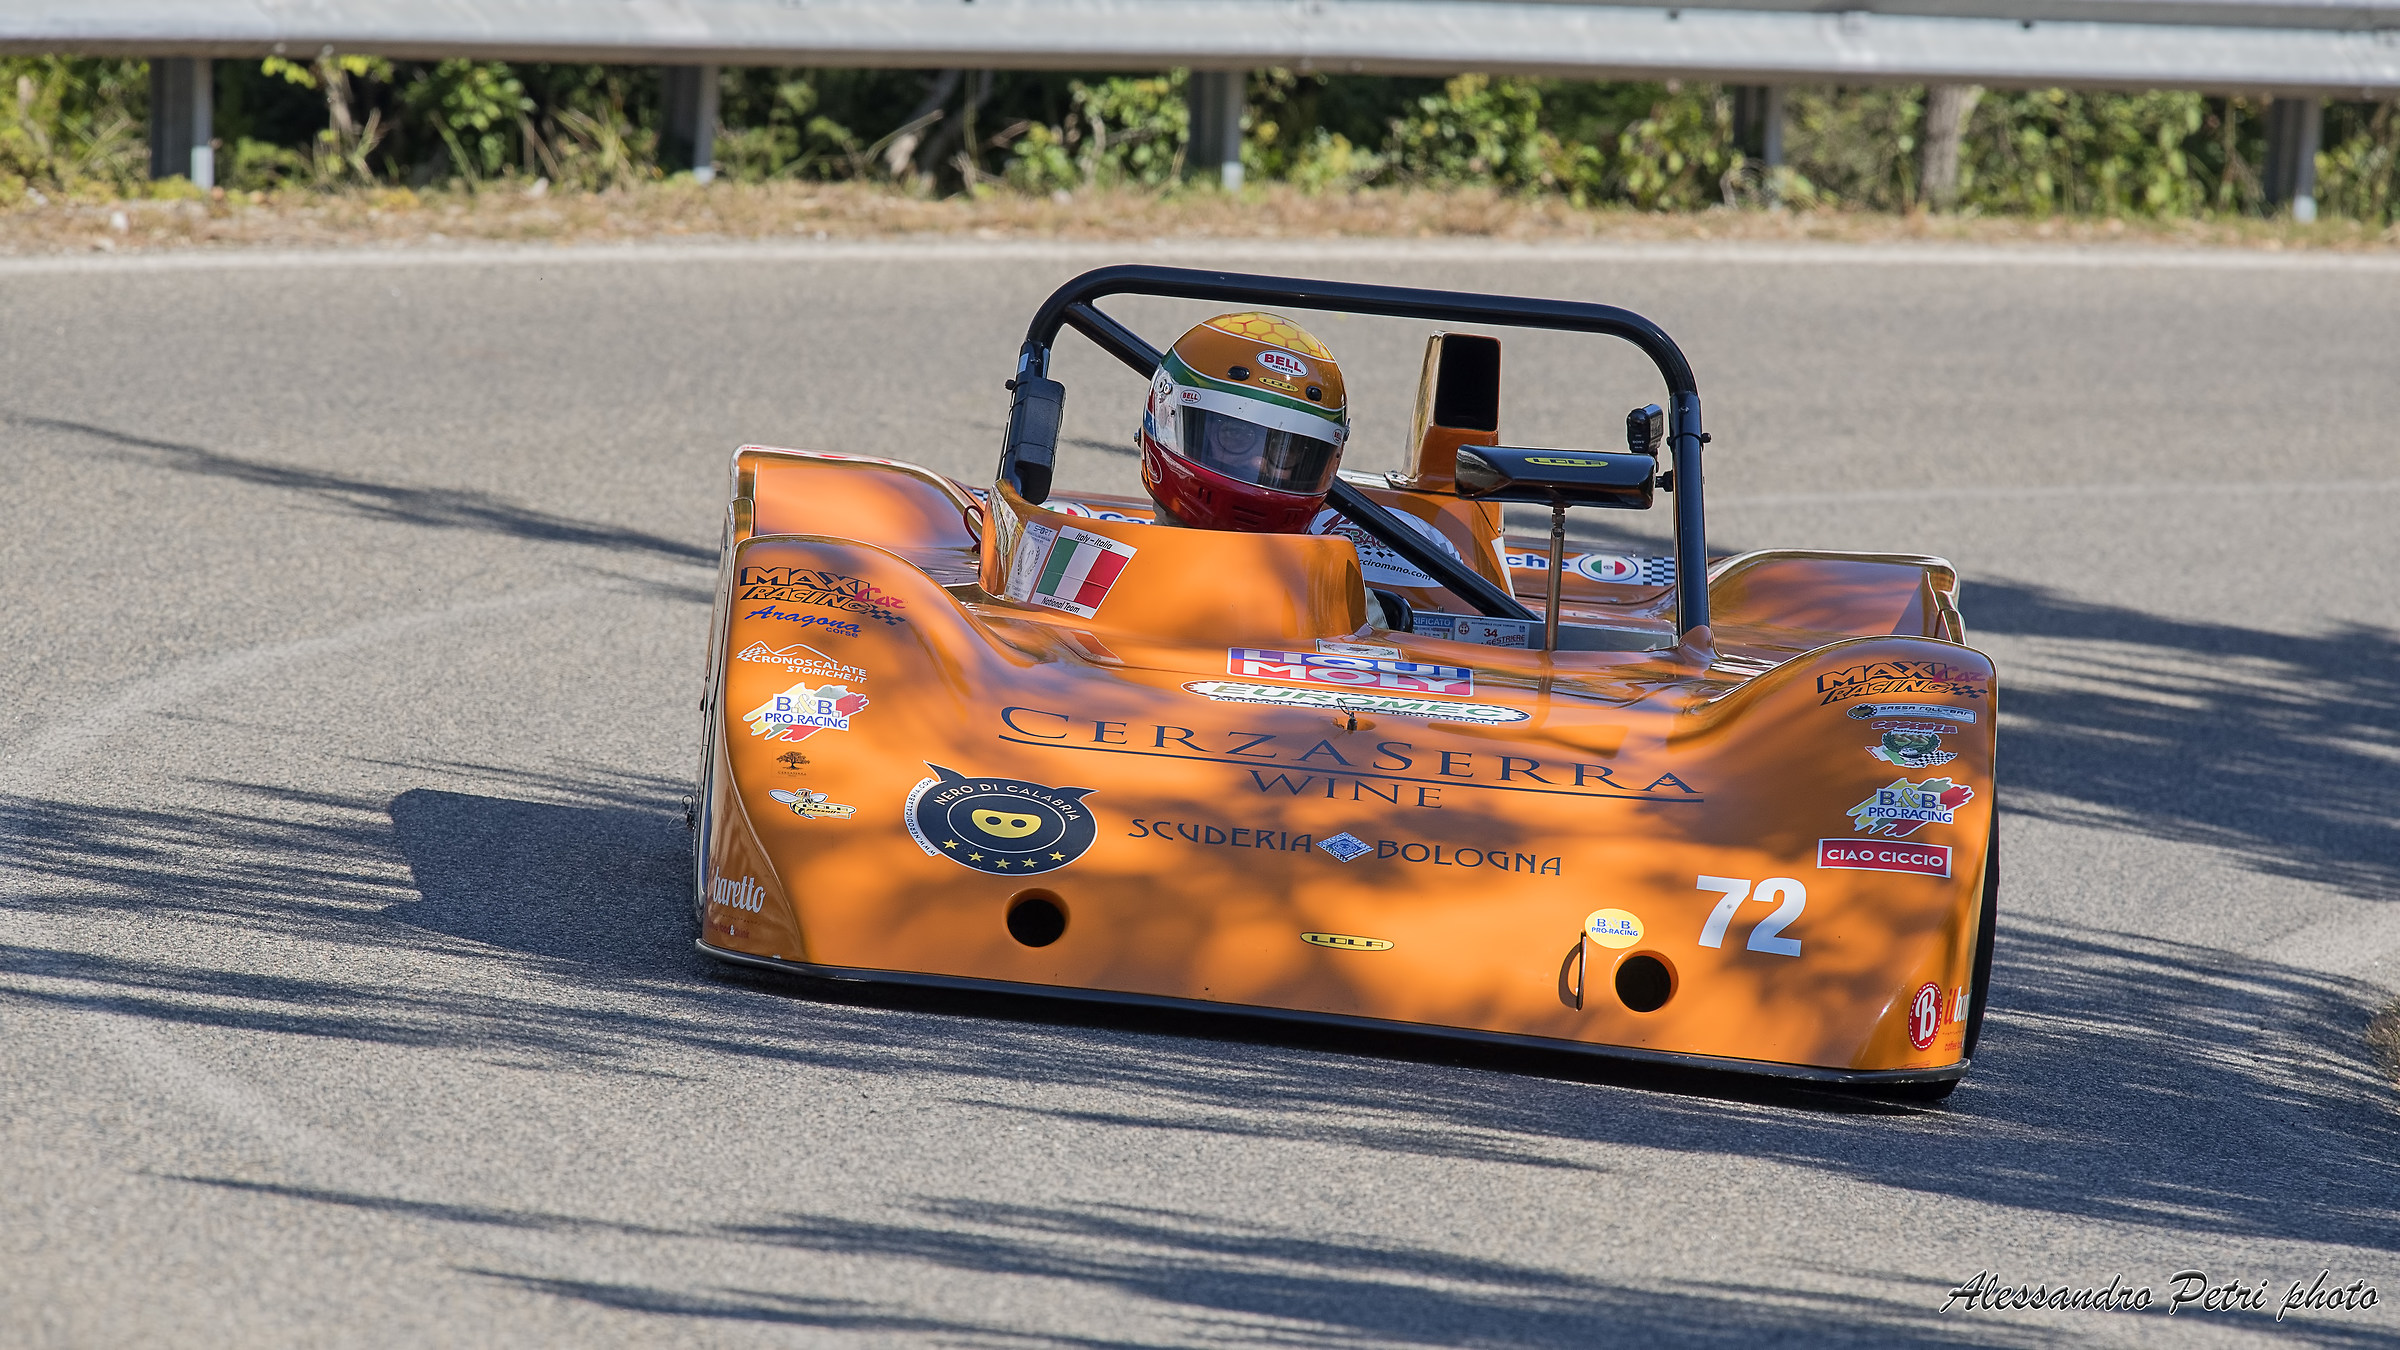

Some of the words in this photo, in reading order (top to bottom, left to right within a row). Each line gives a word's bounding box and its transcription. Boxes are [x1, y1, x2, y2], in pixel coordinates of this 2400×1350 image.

[1264, 353, 1302, 373] BELL
[1182, 392, 1198, 400] BELL
[1075, 532, 1090, 543] Italy
[1095, 538, 1113, 549] Italia
[740, 566, 870, 599] MAXI
[740, 585, 875, 614] RACING
[1041, 596, 1064, 609] National
[1064, 602, 1080, 614] Team
[744, 605, 861, 633] Aragona
[826, 627, 858, 638] corse
[1484, 628, 1498, 637] 34
[752, 656, 867, 676] CRONOSCALATE
[786, 665, 867, 684] STORICHE.IT
[1243, 660, 1467, 692] MOLY
[1244, 649, 1458, 678] LIQUI
[1817, 661, 1948, 693] MAXI
[1212, 685, 1503, 717] EUROMEC
[1820, 680, 1952, 706] RACING
[1000, 706, 1704, 794] CERZASERRA
[933, 785, 974, 806] NERO
[979, 783, 999, 791] DI
[1006, 785, 1081, 822] CALABRIA
[1249, 769, 1443, 809] WINE
[1128, 819, 1312, 853] SCUDERIA
[1377, 840, 1562, 876] BOLOGNA
[1826, 849, 1874, 862] CIAO
[1878, 851, 1944, 867] CICCIO
[713, 866, 766, 913] baretto
[1695, 874, 1807, 957] 72
